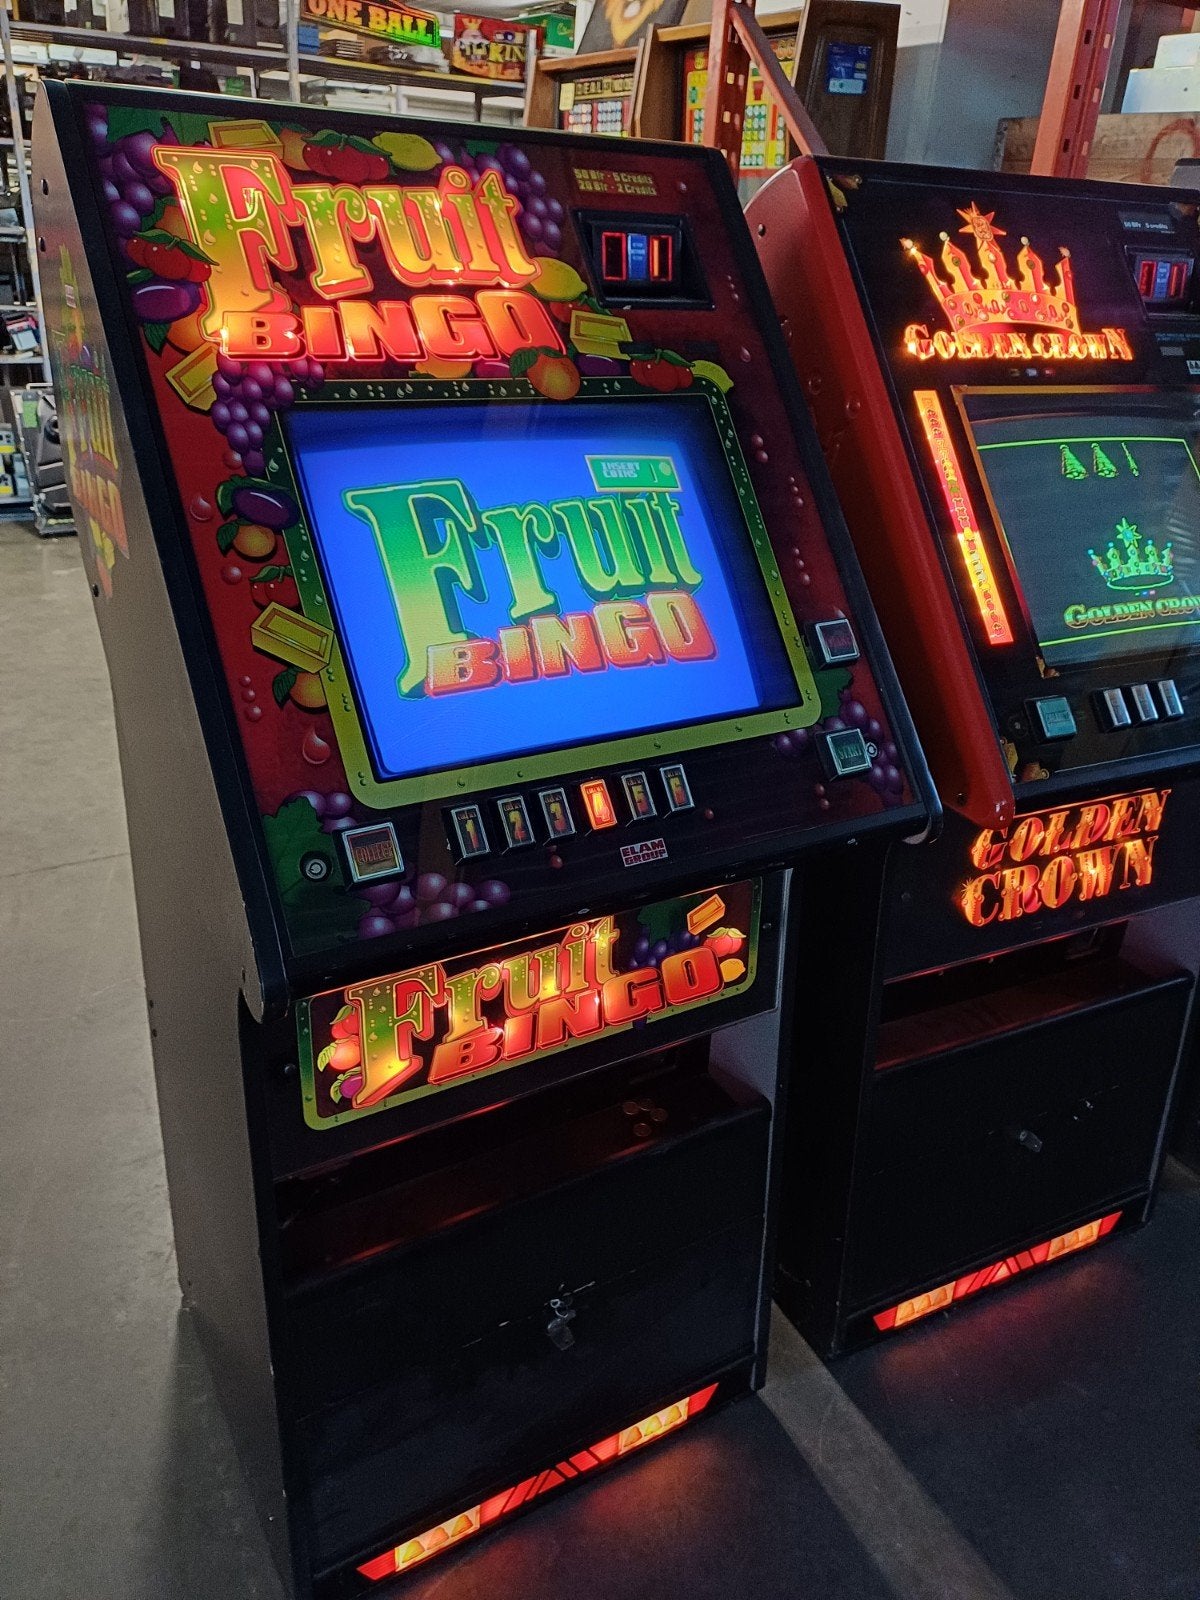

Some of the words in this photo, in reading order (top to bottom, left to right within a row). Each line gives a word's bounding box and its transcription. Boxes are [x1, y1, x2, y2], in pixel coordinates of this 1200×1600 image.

[308, 0, 363, 25] ONE
[367, 5, 433, 42] BALL
[488, 42, 526, 63] KIN
[152, 146, 542, 343] Fruit
[221, 289, 567, 362] BINGO
[600, 461, 640, 470] INSERT
[602, 469, 638, 478] COINS
[342, 477, 703, 700] Fruit
[424, 590, 717, 698] BINGO
[465, 819, 480, 850] 1
[508, 810, 527, 842] 2
[550, 802, 567, 832] 3
[970, 788, 1172, 871] GOLDEN
[621, 840, 665, 858] ELAM
[624, 849, 667, 866] GROUP
[962, 835, 1158, 927] CROWN
[345, 916, 622, 1110] Fruit
[427, 946, 725, 1086] BINGO
